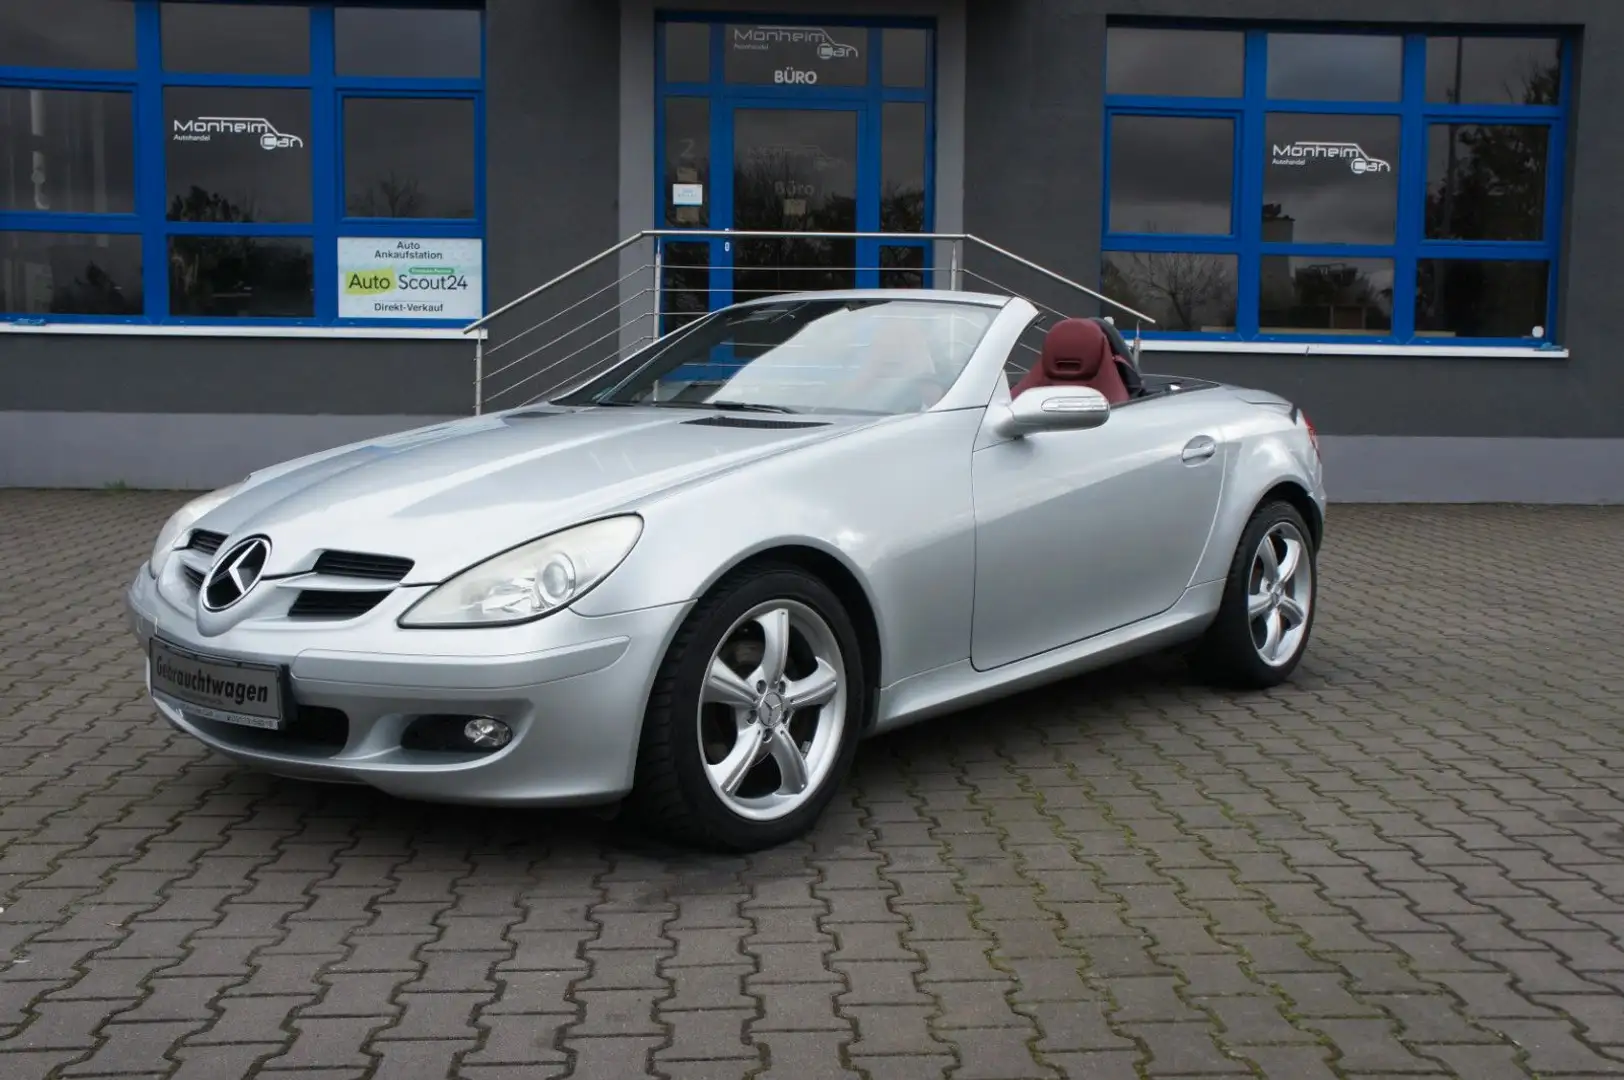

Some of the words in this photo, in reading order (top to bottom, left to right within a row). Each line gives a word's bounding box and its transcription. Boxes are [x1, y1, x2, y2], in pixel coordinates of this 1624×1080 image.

[734, 29, 825, 42] Monheim
[774, 66, 817, 84] BÜRO
[173, 120, 268, 132] Monheim
[173, 134, 210, 142] Autohandel
[1272, 144, 1359, 157] Monheim
[397, 241, 421, 250] Auto
[374, 250, 443, 260] Ankaufstation
[348, 274, 391, 289] Auto
[398, 274, 469, 290] Scout24
[374, 303, 444, 312] Direkt-Verkauf
[157, 655, 268, 705] Gebrauchtwagen
